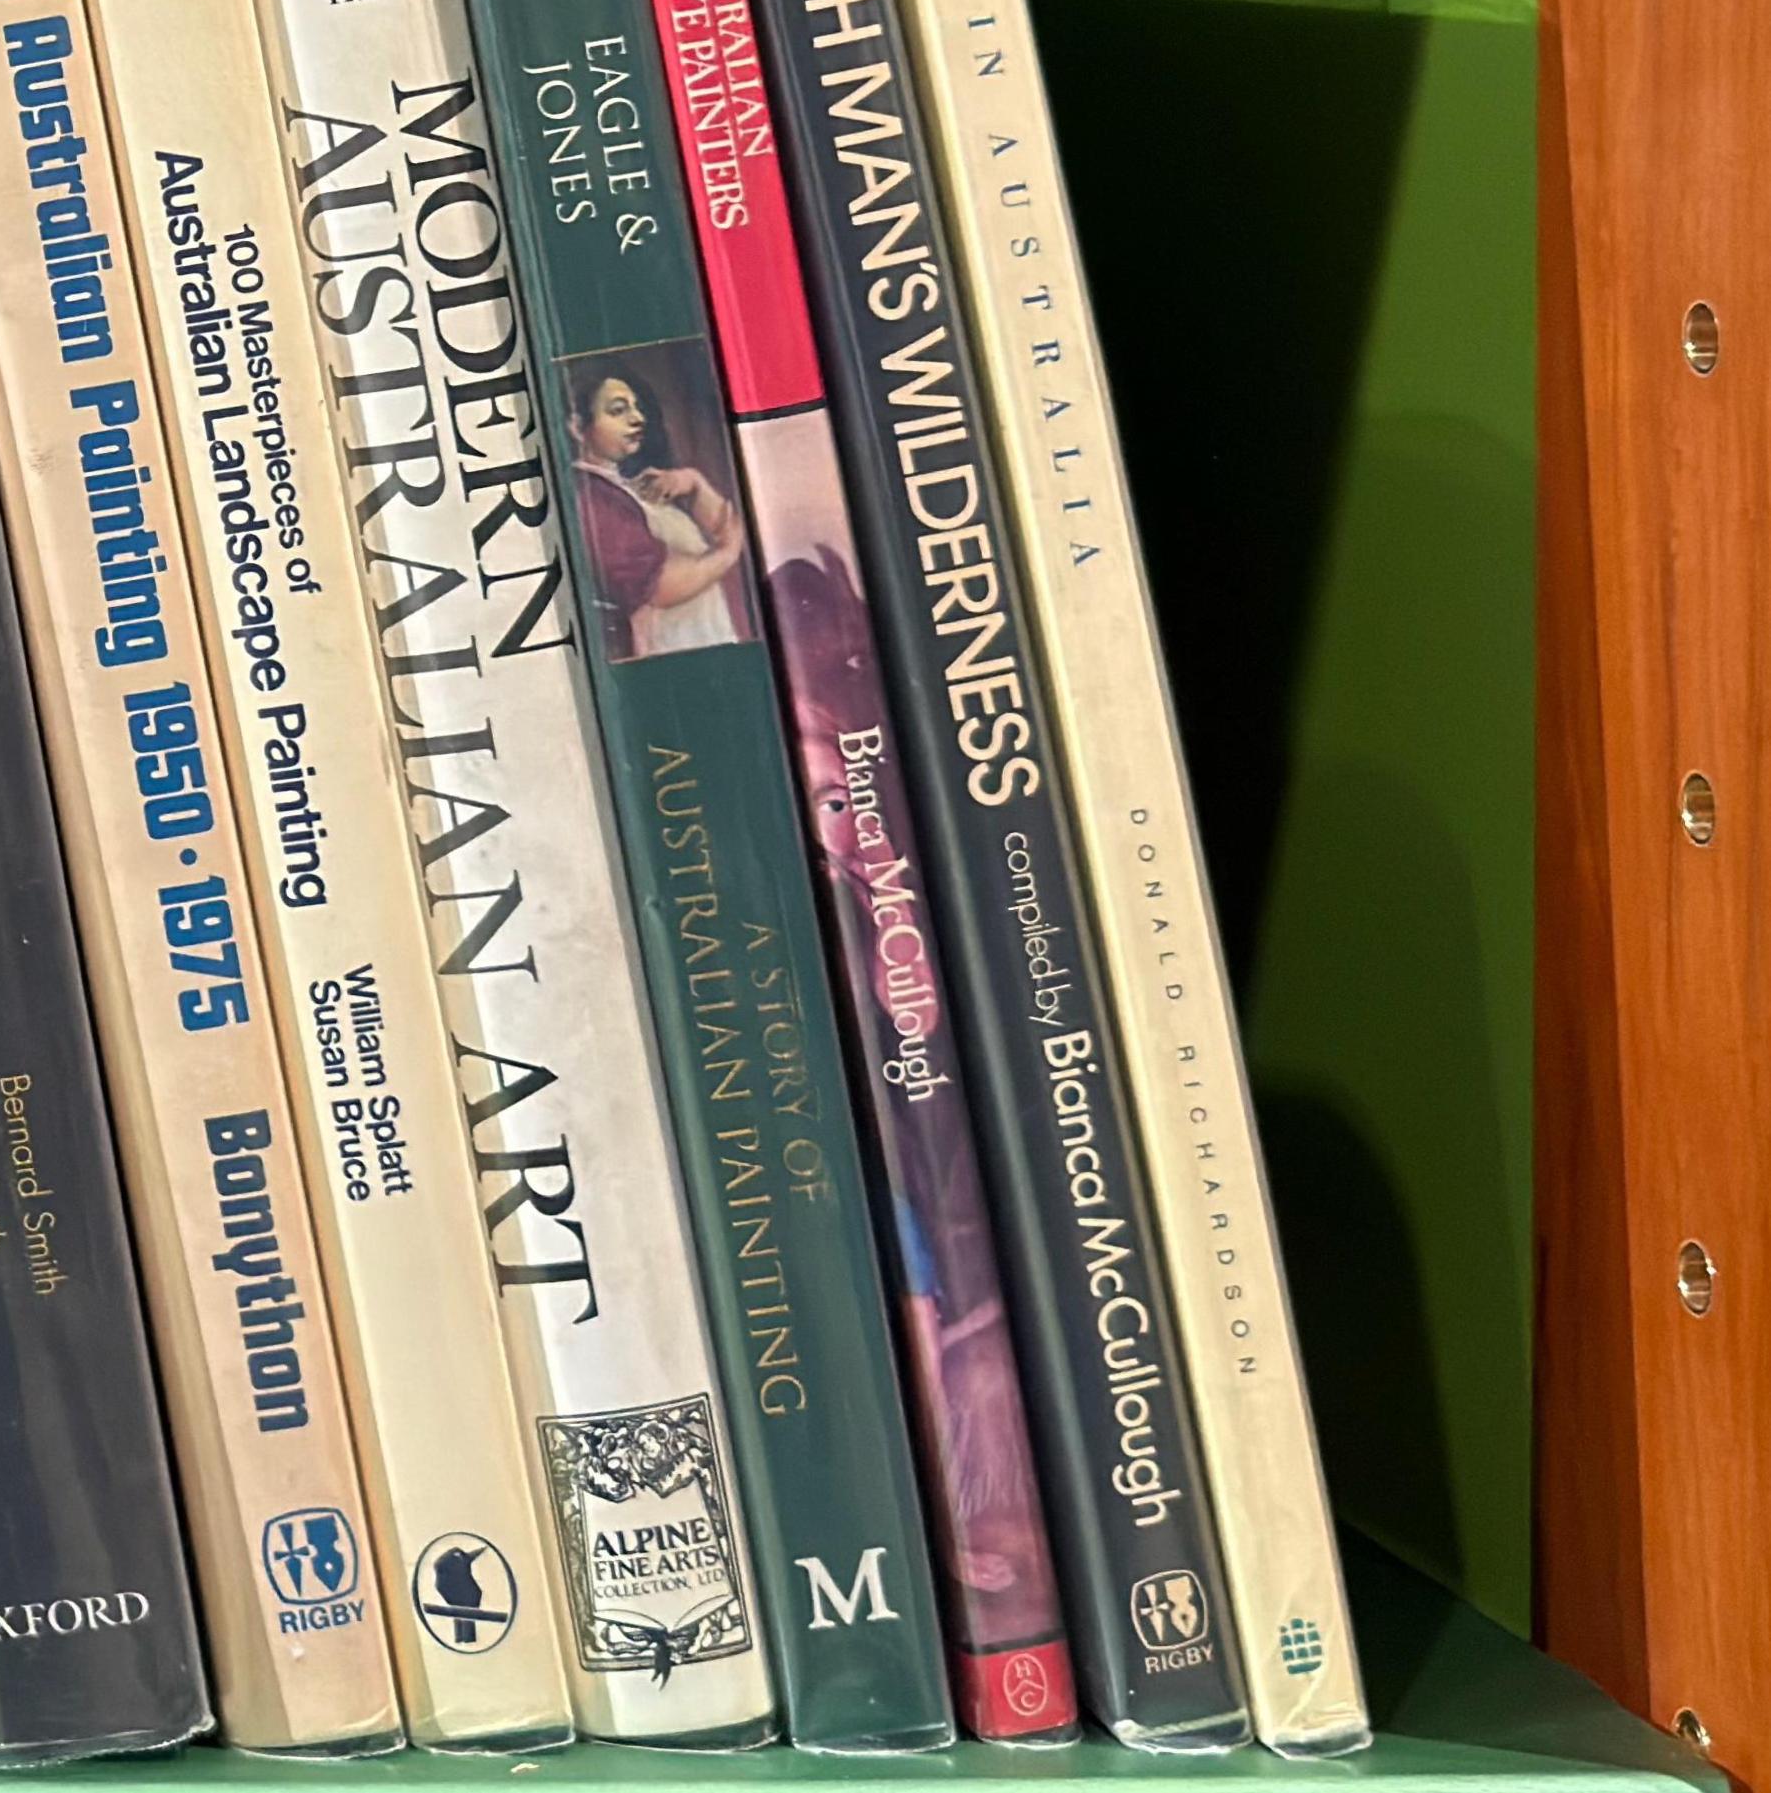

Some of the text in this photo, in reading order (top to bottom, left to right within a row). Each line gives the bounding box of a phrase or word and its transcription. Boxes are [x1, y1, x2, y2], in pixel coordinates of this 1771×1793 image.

[521, 56, 597, 227] JONES
[581, 33, 651, 197] EAGLE
[676, 35, 749, 232] PAINTERS
[0, 12, 127, 365] Australian
[67, 378, 181, 668] Painting
[222, 222, 321, 596] 100 Masterpieces of
[389, 65, 578, 670] MODERN
[965, 12, 1007, 80] IN
[986, 127, 1103, 568] AUSTRALIA
[152, 143, 340, 912] Australian Landscape Painting
[873, 325, 1044, 811] WILDERNESS
[279, 80, 601, 1337] AUSTRALIAN ART
[342, 962, 415, 1198] William Splatt
[643, 738, 809, 1419] AUSTRALIAN PAINTING
[836, 722, 952, 1106] Bianca McCullough
[20, 1209, 67, 1297] Smith
[306, 976, 378, 1203] Susan Bruce
[992, 827, 1187, 1530] compiled by Bianca McCullough
[1129, 806, 1259, 1375] DONALD RICHARDSON
[187, 1108, 325, 1433] Bonython
[277, 1598, 367, 1634] RIGBY
[593, 1517, 712, 1557] ALPINE
[794, 1542, 899, 1634] M
[1143, 1643, 1218, 1675] RIGBY
